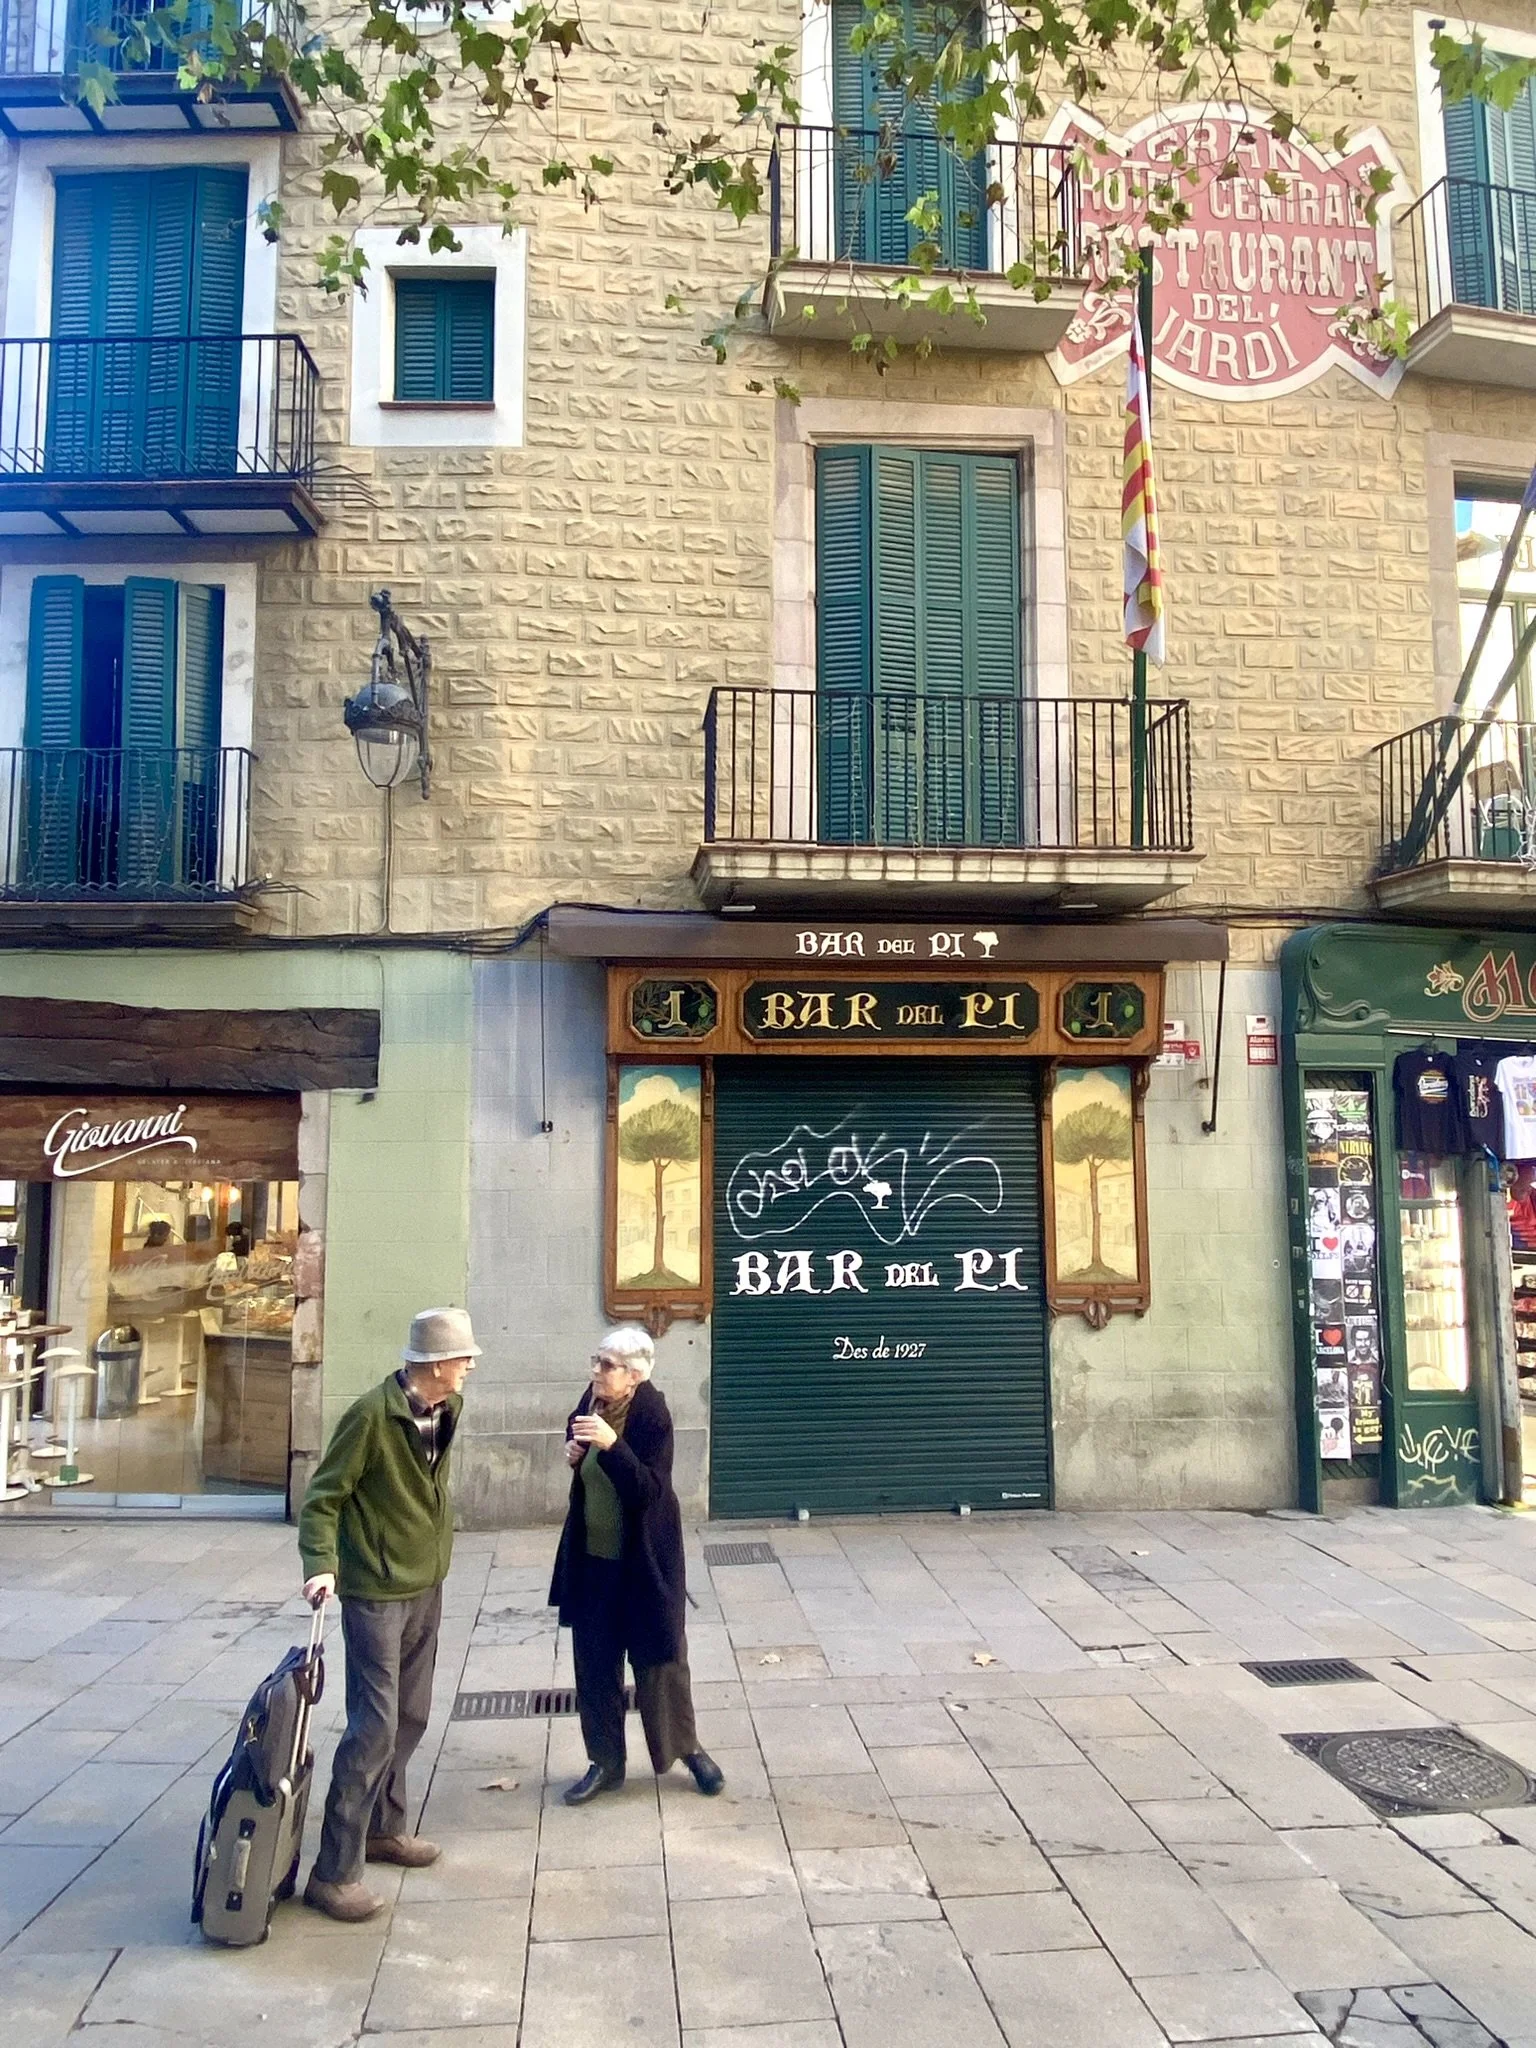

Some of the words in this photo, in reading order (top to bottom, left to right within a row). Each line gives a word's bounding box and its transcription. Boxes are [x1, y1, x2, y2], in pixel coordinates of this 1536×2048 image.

[1146, 117, 1301, 172] GRAN
[1077, 160, 1194, 217] HOTEL
[1208, 171, 1372, 229] CENTRAL
[1076, 221, 1374, 298] RESTAURANT
[796, 931, 865, 957] BAR
[877, 938, 915, 955] DEL
[929, 932, 966, 957] PI
[658, 991, 688, 1028] 1
[1085, 992, 1113, 1028] 1
[1462, 951, 1536, 1022] M
[758, 992, 881, 1031] BAR
[896, 1004, 944, 1026] DEL
[958, 992, 1026, 1031] PI
[43, 1104, 197, 1177] Giovanni
[729, 1249, 869, 1296] BAR
[884, 1262, 940, 1288] DEL
[954, 1248, 1028, 1292] PI
[894, 1343, 927, 1359] 1927
